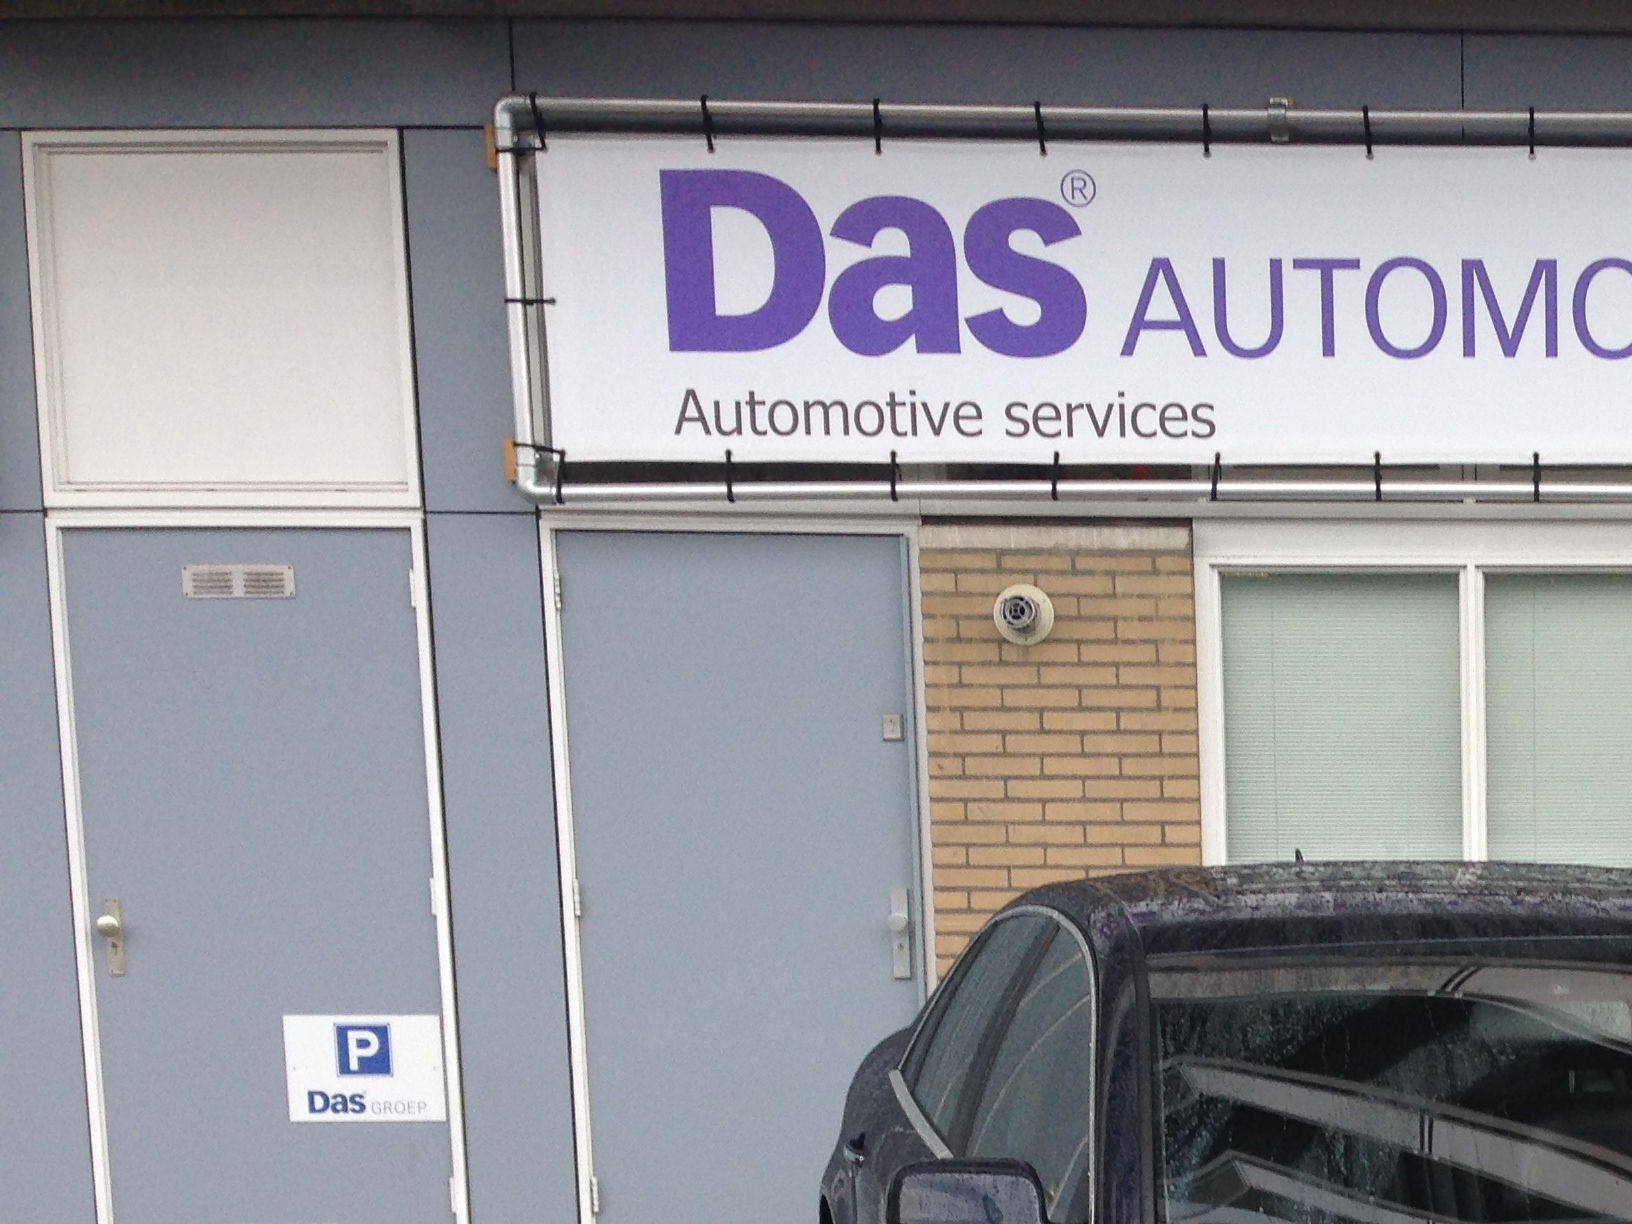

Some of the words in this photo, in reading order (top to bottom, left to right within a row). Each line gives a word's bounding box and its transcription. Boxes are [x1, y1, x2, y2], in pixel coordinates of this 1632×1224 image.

[659, 168, 1088, 358] Das
[674, 388, 984, 438] Automotive
[1004, 391, 1217, 439] services
[346, 1029, 380, 1072] P
[307, 1090, 366, 1114] Das
[371, 1100, 427, 1115] GROEP
